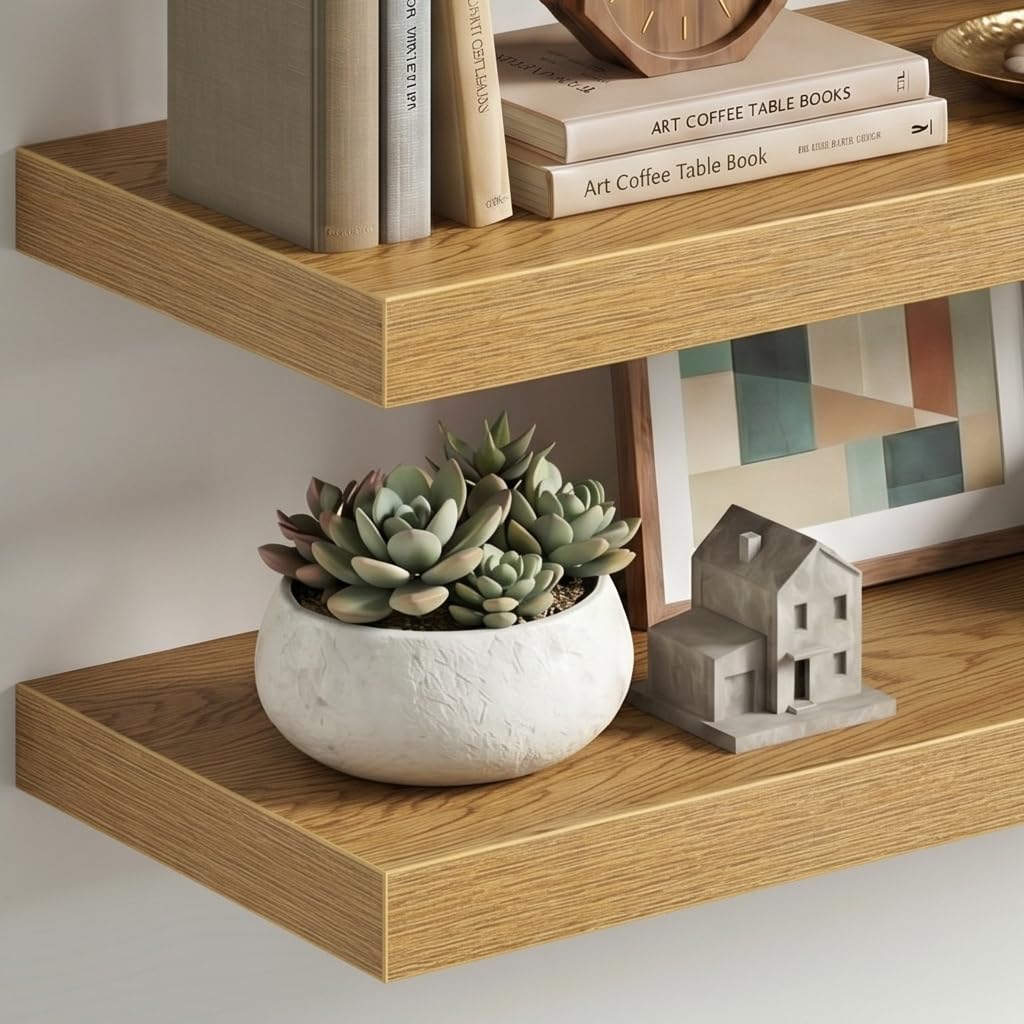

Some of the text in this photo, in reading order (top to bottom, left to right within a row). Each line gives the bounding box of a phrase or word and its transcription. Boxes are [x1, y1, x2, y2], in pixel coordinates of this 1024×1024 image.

[651, 86, 851, 135] ART COFFEE TABLE BOOKS
[584, 147, 767, 198] Art Coffee Table Book
